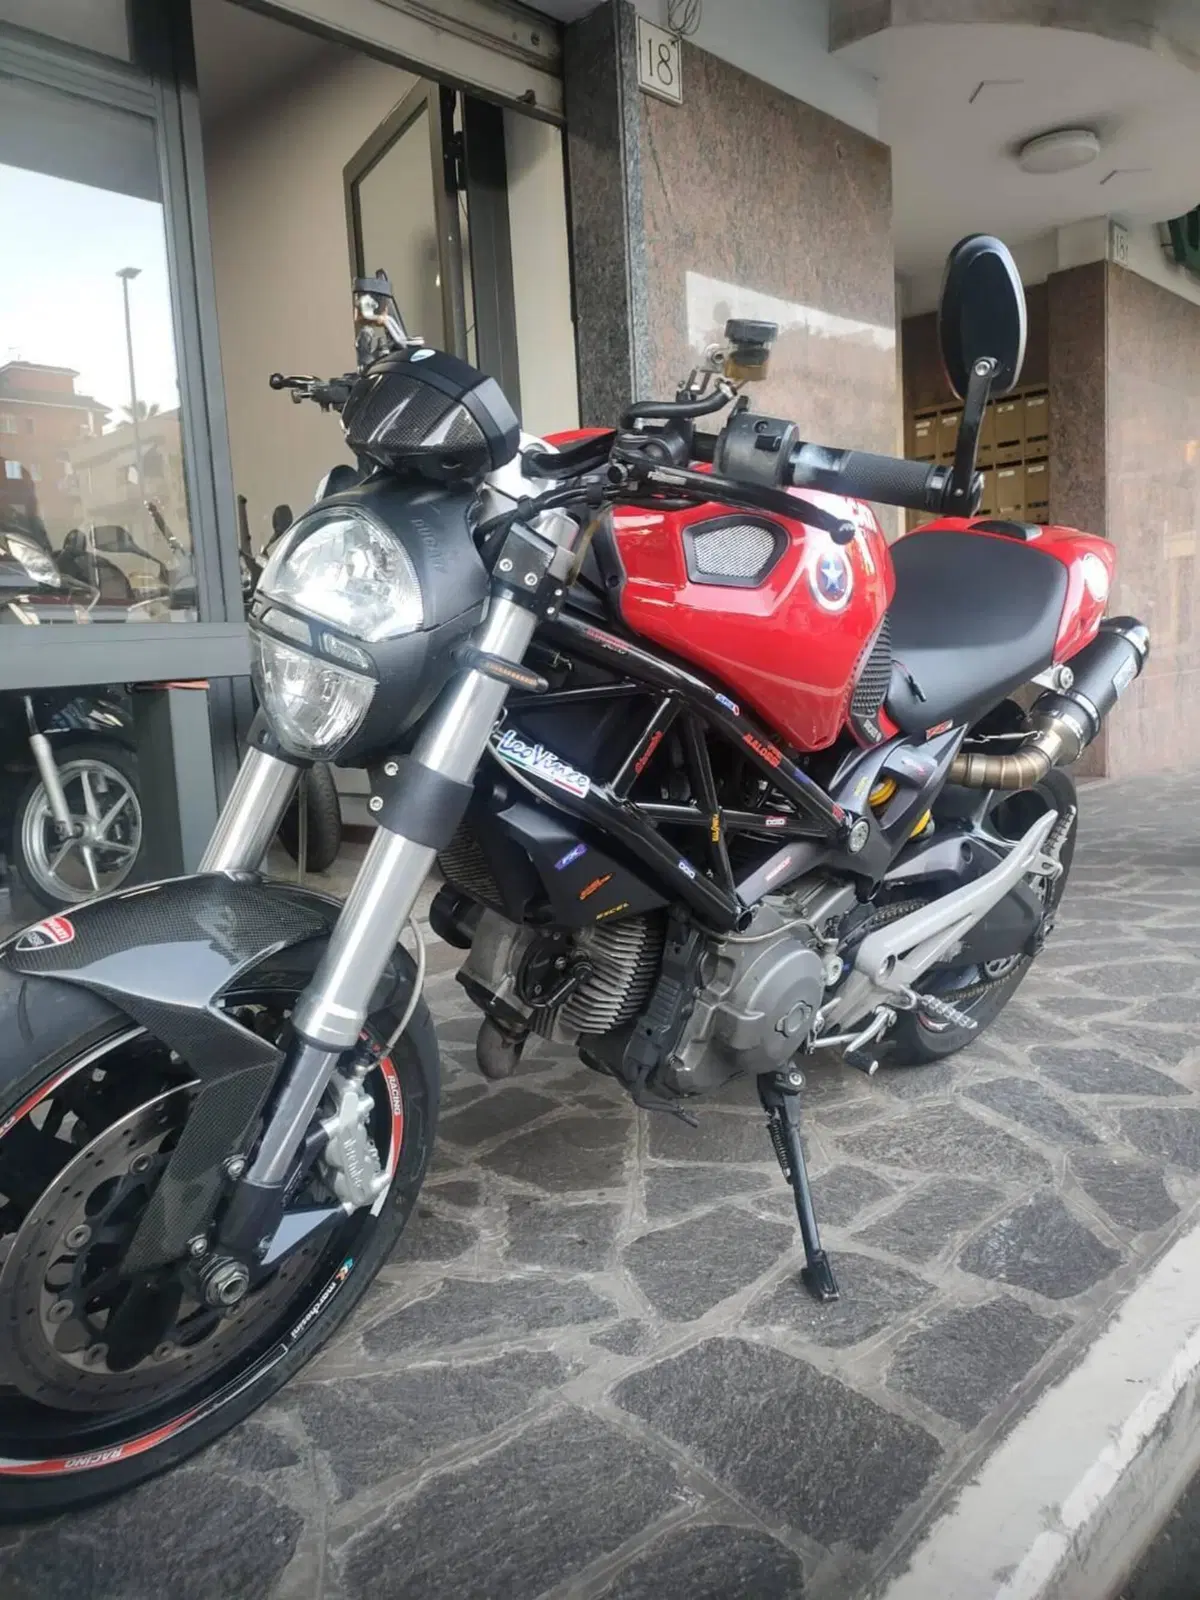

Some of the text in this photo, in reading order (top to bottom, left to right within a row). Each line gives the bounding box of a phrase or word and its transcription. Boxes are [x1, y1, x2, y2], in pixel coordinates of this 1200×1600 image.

[648, 38, 673, 86] 18
[500, 731, 588, 788] LeoVince
[387, 1075, 401, 1116] RACING
[291, 1281, 337, 1339] marchesini
[64, 1447, 122, 1468] RACING
